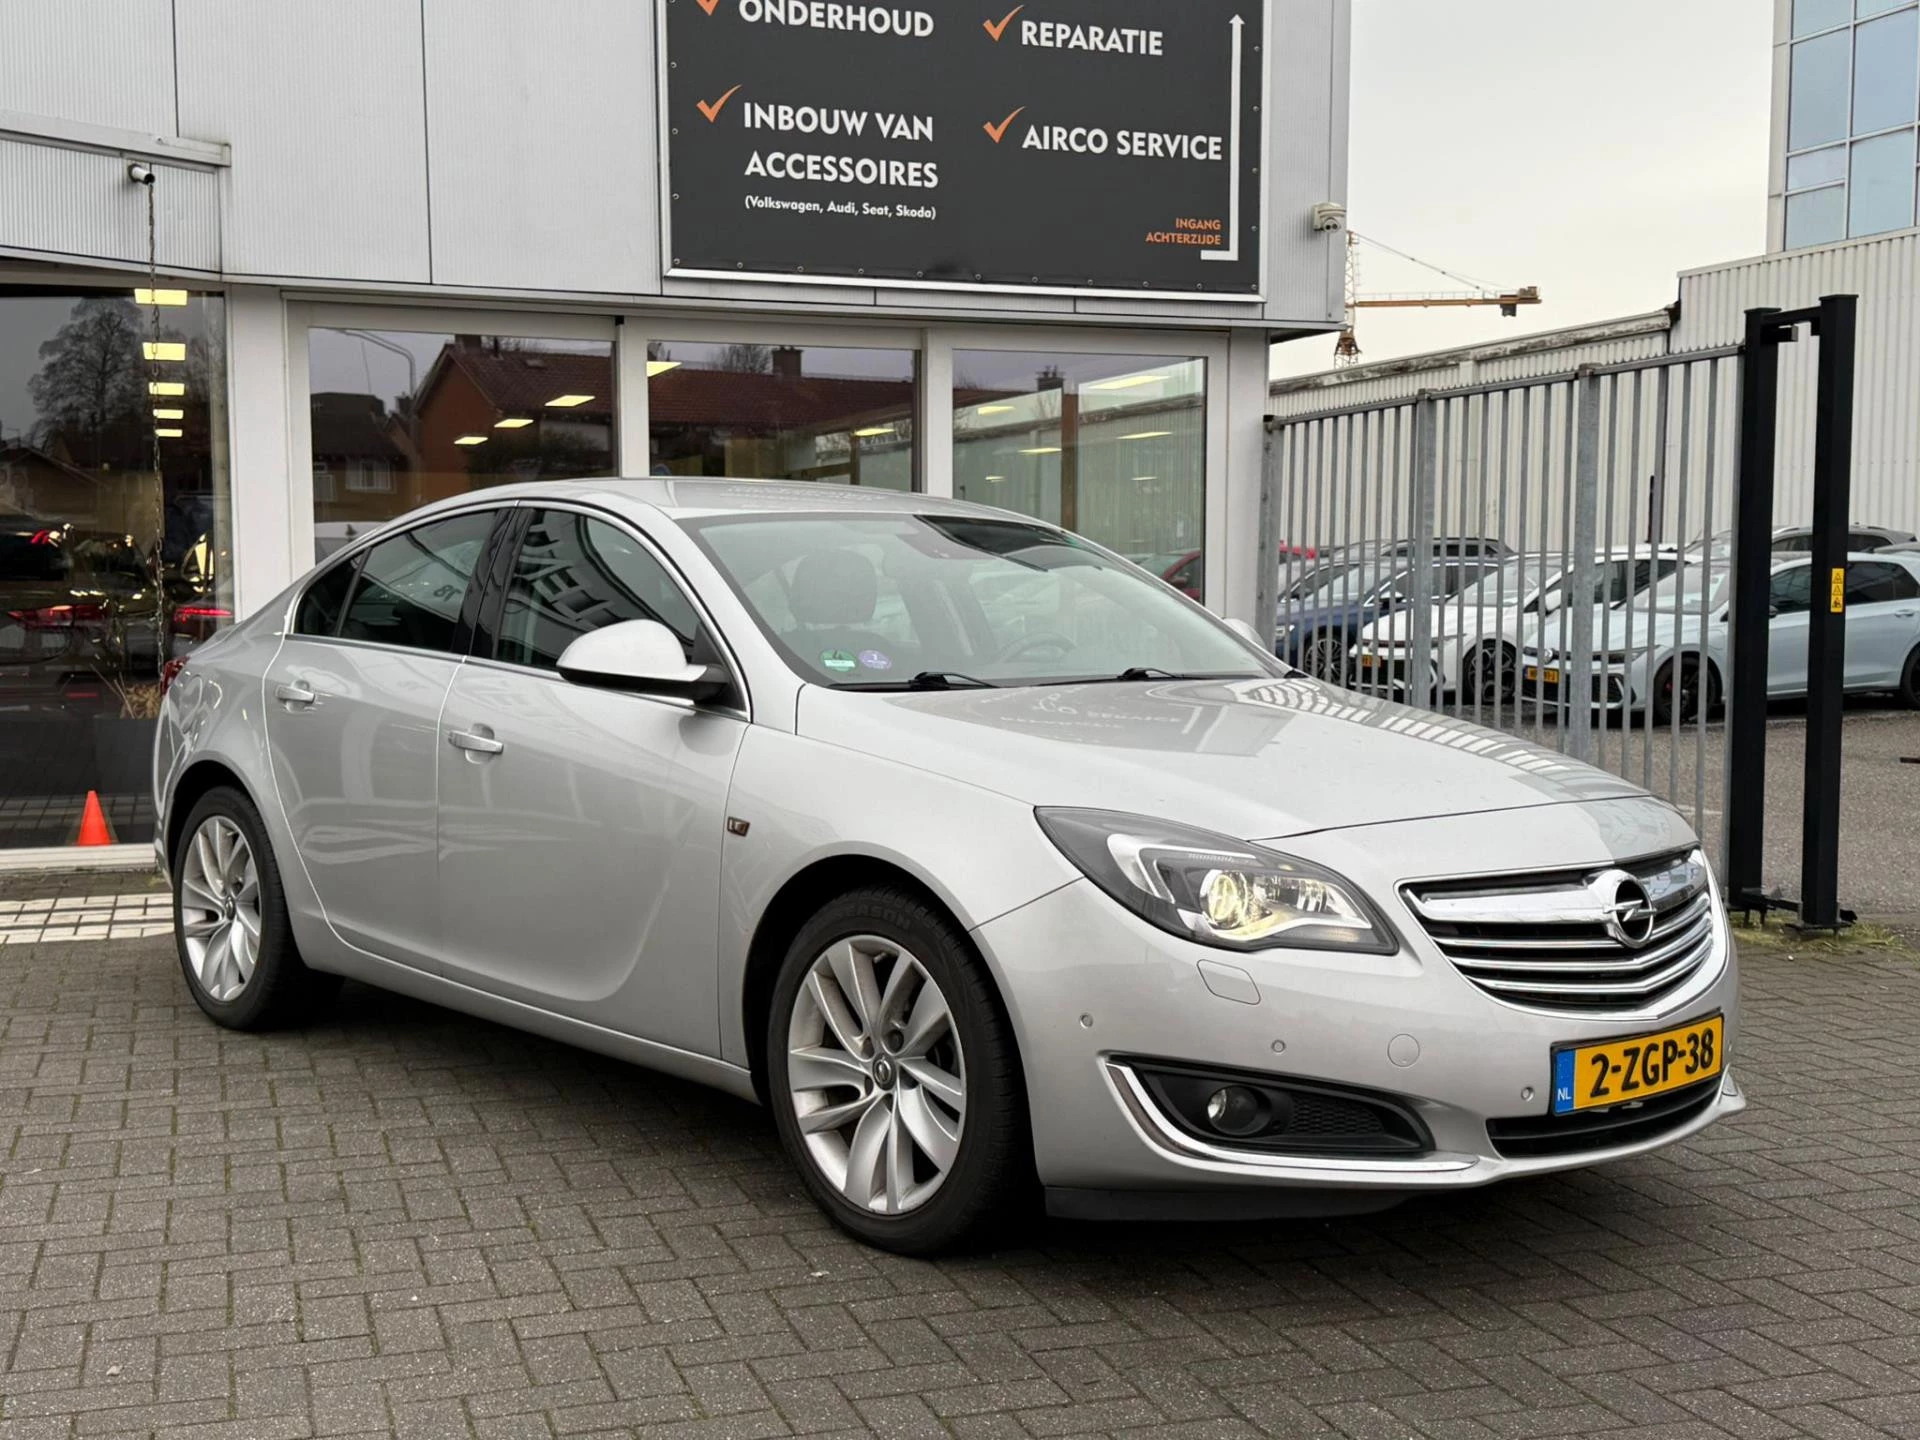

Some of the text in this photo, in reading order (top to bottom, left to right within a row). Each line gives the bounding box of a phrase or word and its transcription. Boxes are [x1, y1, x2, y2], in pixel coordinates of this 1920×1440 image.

[738, 0, 935, 37] ONDERHOUD
[1021, 20, 1163, 56] REPARATIE
[744, 102, 933, 142] INBOUW VAN
[1022, 125, 1223, 161] AIRCO SERVICE
[744, 150, 939, 189] ACCESSOIRES
[744, 195, 936, 220] (Volkswagen, Audi, Seat, Skoda)
[1175, 218, 1221, 230] INGANG
[1145, 231, 1221, 245] ACHTERZIJDE
[1590, 1027, 1714, 1098] 2-ZGP-38
[1557, 1087, 1572, 1101] NL
